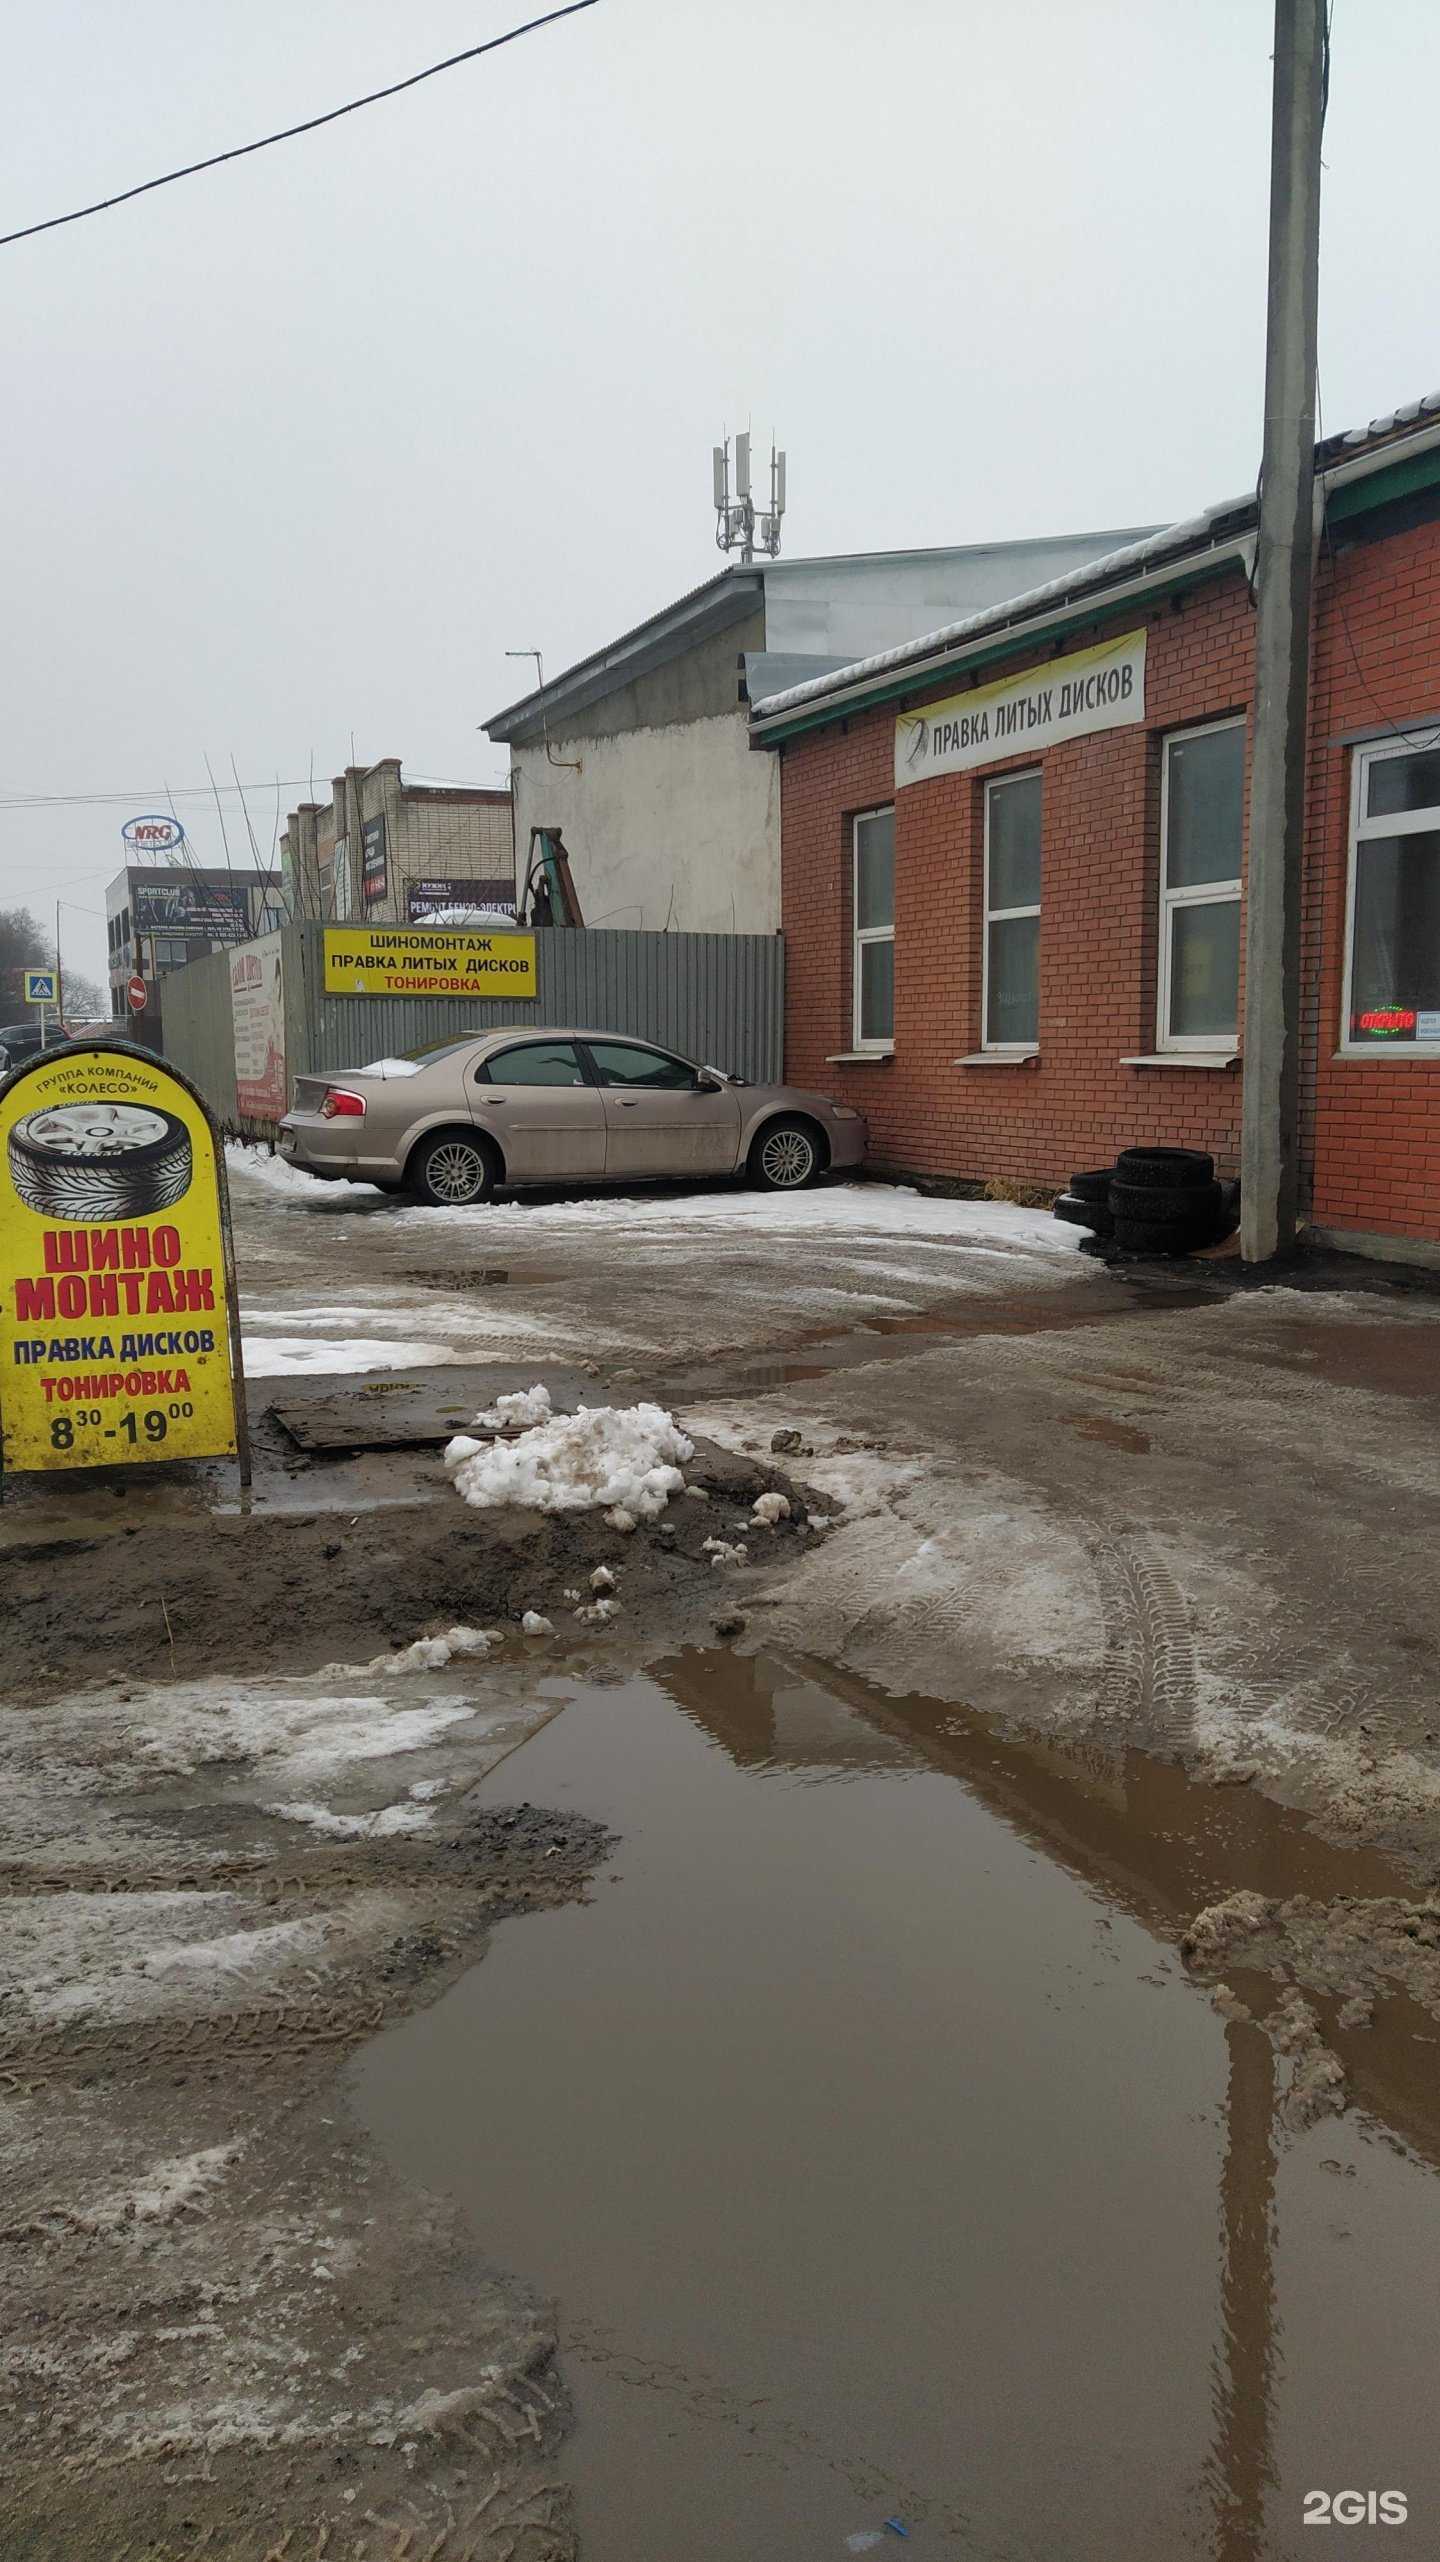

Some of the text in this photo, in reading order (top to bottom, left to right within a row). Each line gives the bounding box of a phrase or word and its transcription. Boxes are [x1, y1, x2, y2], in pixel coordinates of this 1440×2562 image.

[933, 664, 1133, 756] ПРАВКА ЛИТЫХ ДИСКОВ
[135, 825, 171, 840] NRG
[370, 935, 492, 951] ШИНОМОНТАЖ
[331, 955, 529, 973] ПРАВКА ЛИТЫХ ДИСКОВ
[384, 976, 481, 991] ТОНИРОВКА
[36, 1067, 158, 1093] ГРУППА КОМПАНИЙ
[59, 1083, 137, 1094] «КОЛЕСО»
[43, 1225, 182, 1273] ШИНО
[15, 1269, 215, 1321] МОНТАЖ
[14, 1330, 215, 1365] ПРАВКА ДИСКОВ
[40, 1369, 191, 1402] ТОНИРОВКА
